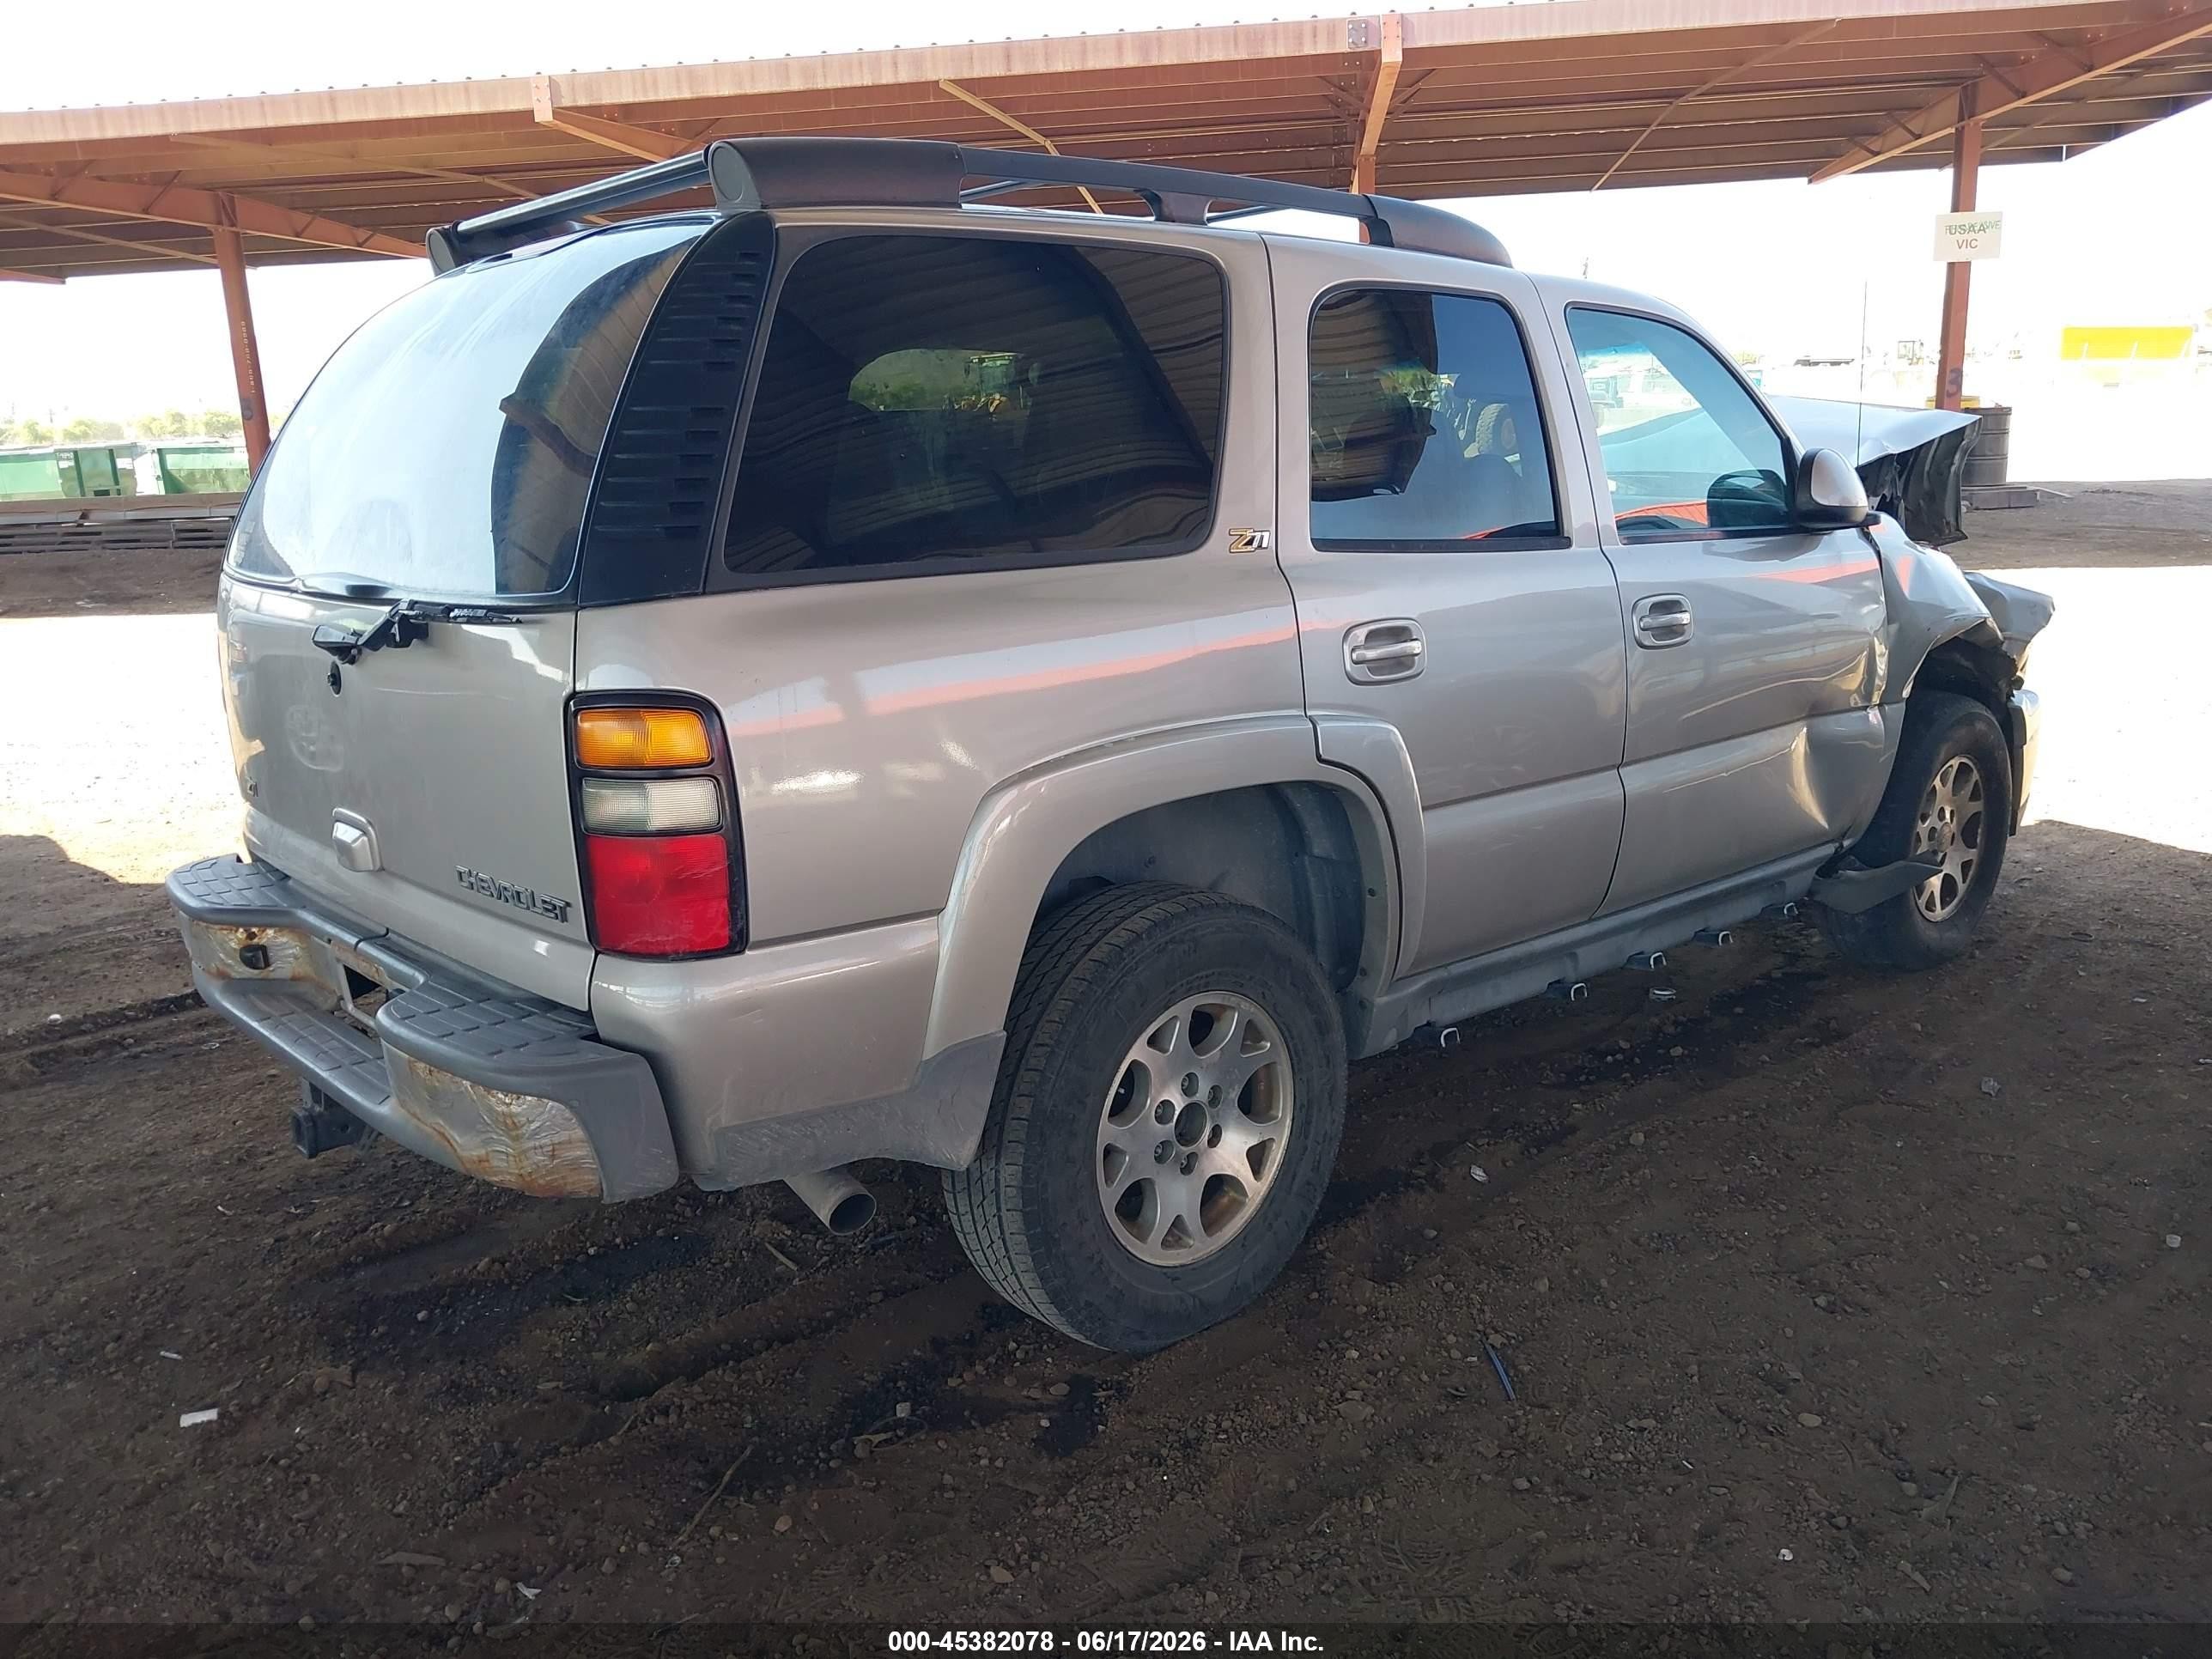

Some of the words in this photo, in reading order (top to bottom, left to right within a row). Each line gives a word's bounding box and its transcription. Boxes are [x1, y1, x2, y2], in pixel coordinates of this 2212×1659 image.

[1949, 223, 1986, 235] USAA
[1956, 239, 1978, 249] VIC
[1946, 368, 1961, 398] 3
[455, 865, 572, 923] CHEVROLET
